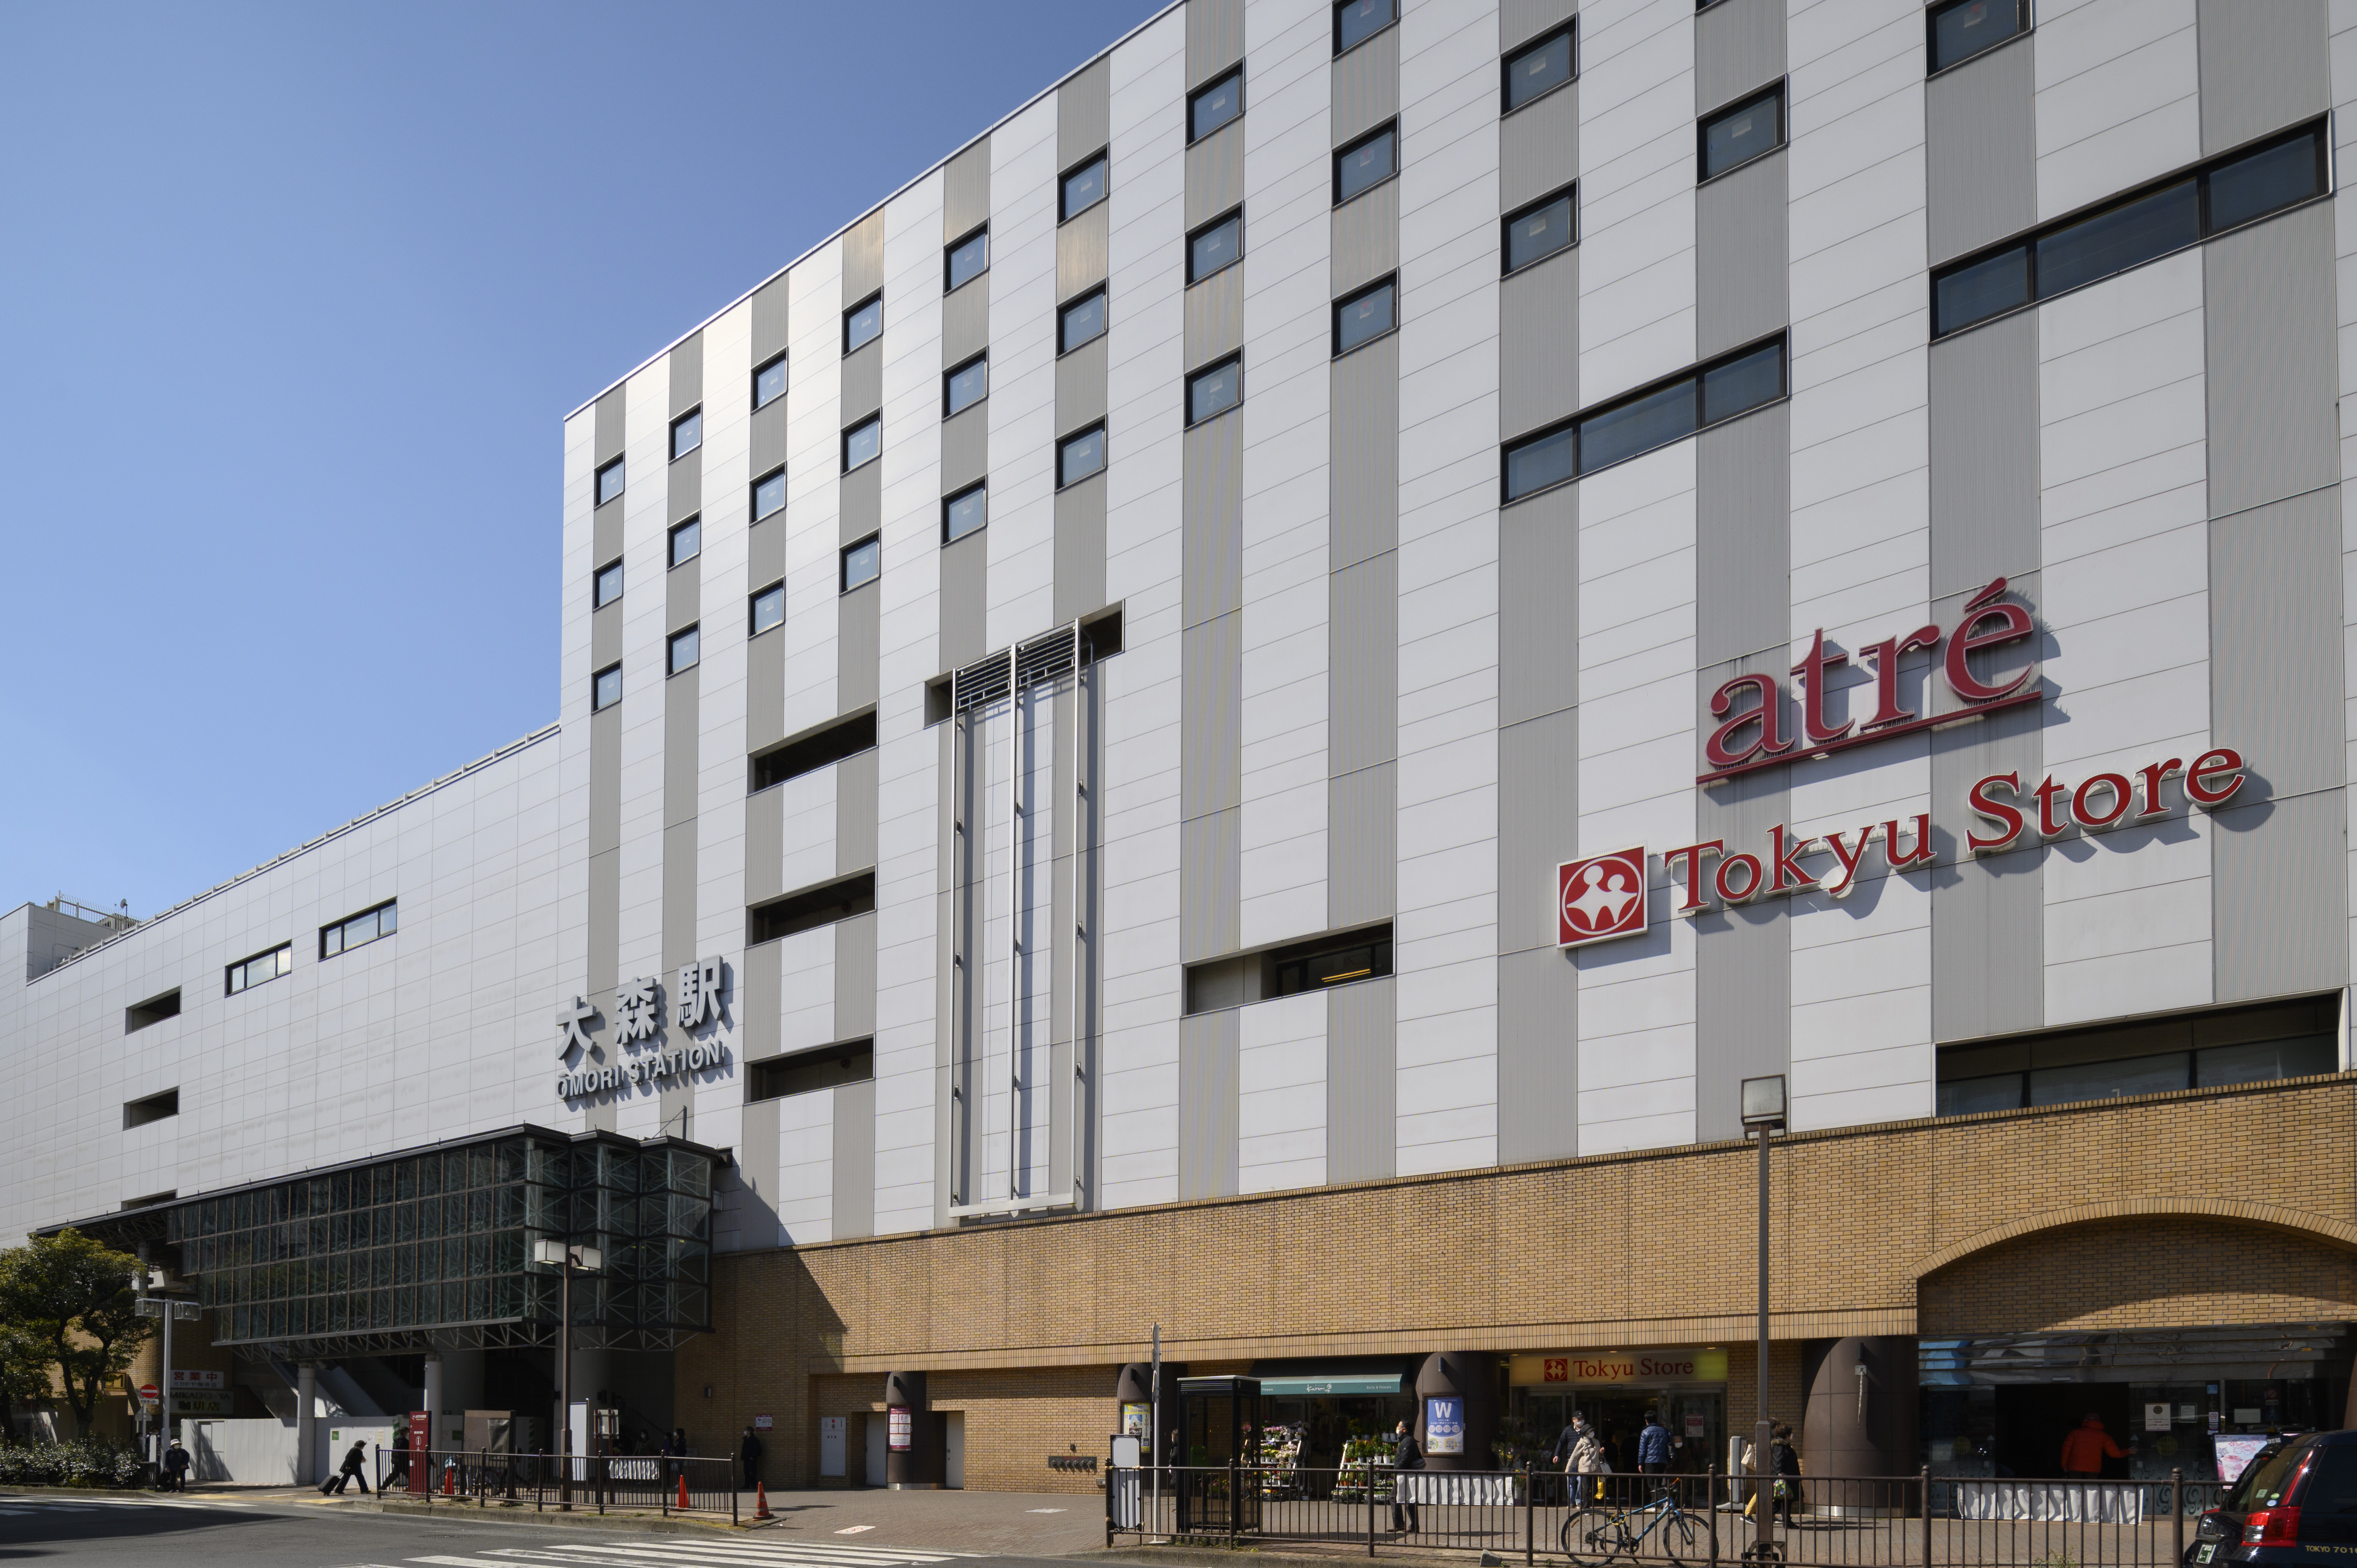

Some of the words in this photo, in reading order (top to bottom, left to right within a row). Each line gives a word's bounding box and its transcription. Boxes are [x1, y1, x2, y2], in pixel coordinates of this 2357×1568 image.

[1705, 576, 2035, 767] atré
[1664, 812, 1937, 913] Tokyu
[1965, 746, 2247, 854] Store
[555, 955, 724, 1060] 大森駅
[628, 1040, 722, 1084] STATION
[174, 1371, 217, 1381] 営業中
[1574, 1359, 1634, 1380] Tokyu
[1640, 1358, 1694, 1375] Store
[1435, 1402, 1452, 1419] W
